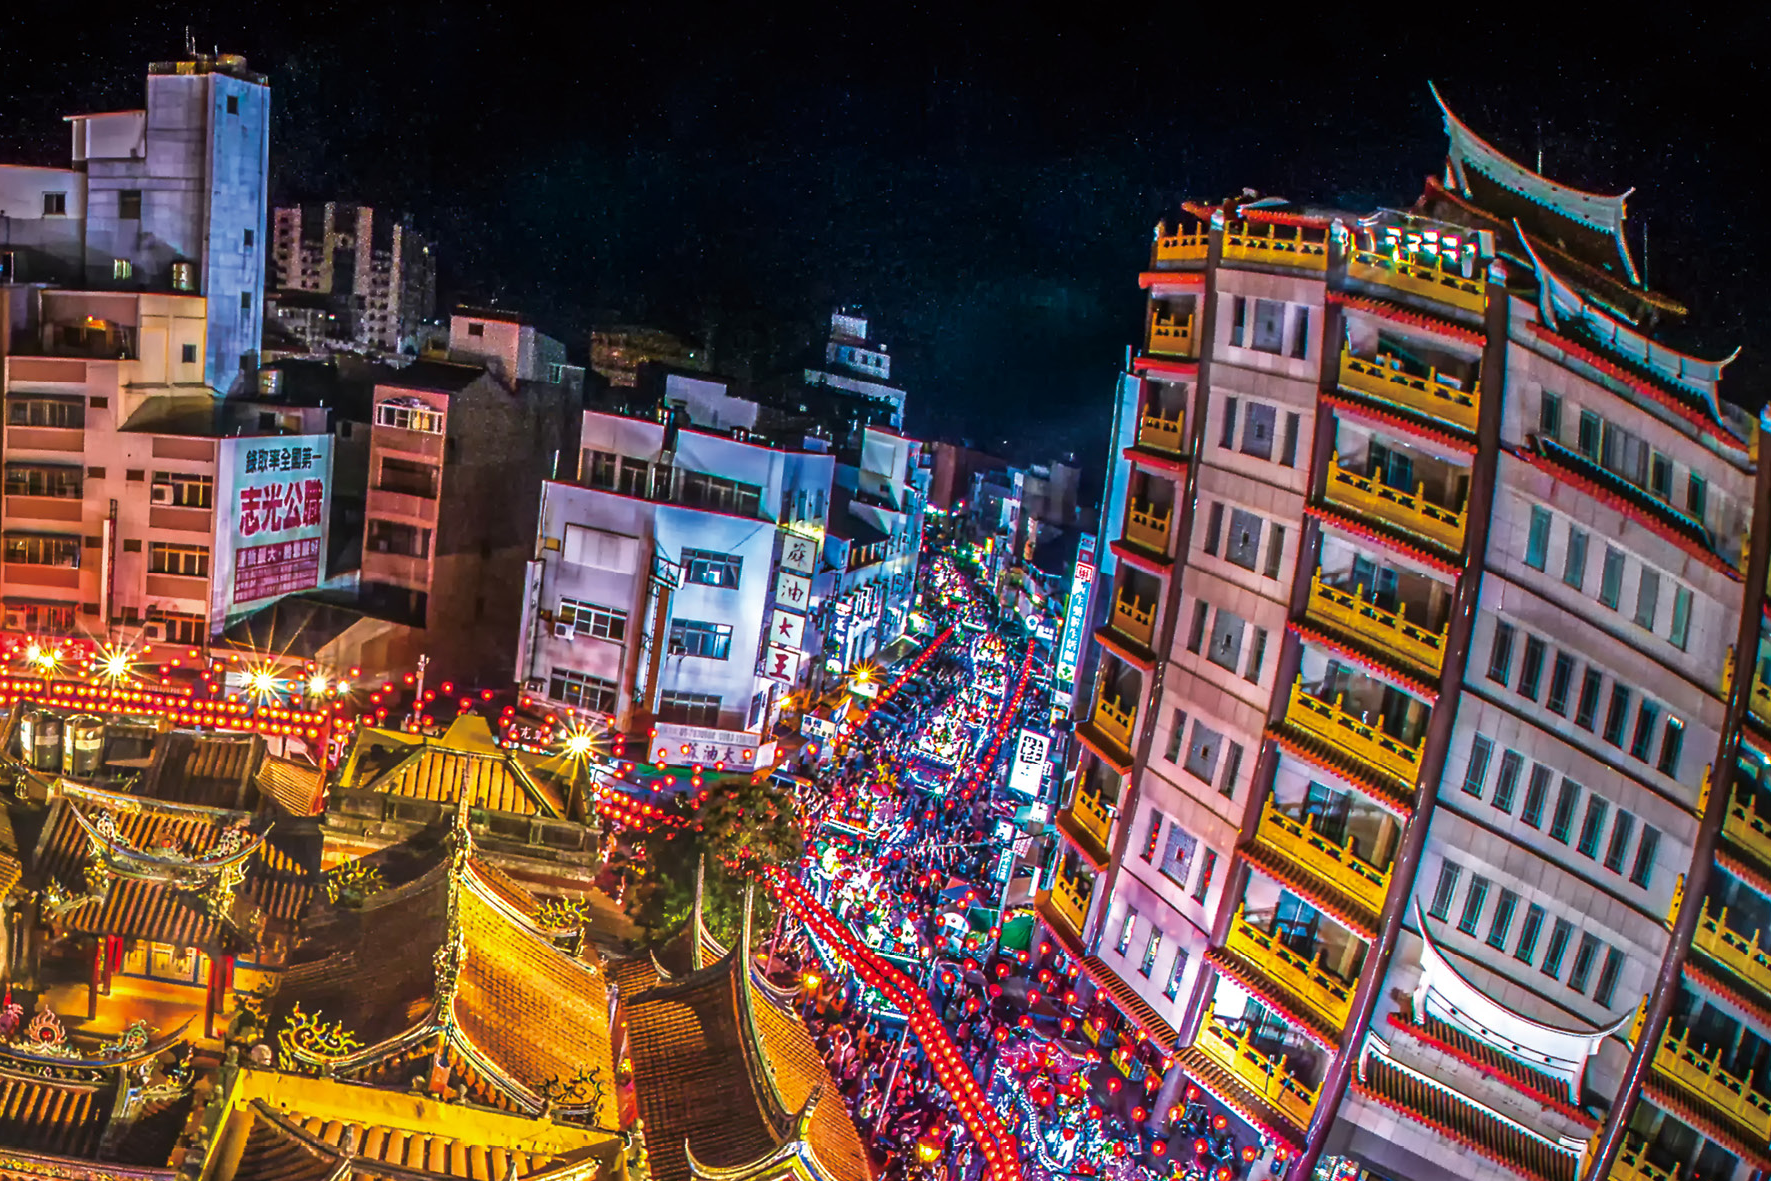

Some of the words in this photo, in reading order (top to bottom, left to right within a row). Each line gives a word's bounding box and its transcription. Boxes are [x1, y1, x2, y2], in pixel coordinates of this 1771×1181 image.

[239, 479, 324, 537] 志光公職
[768, 542, 807, 682] 麻油大王
